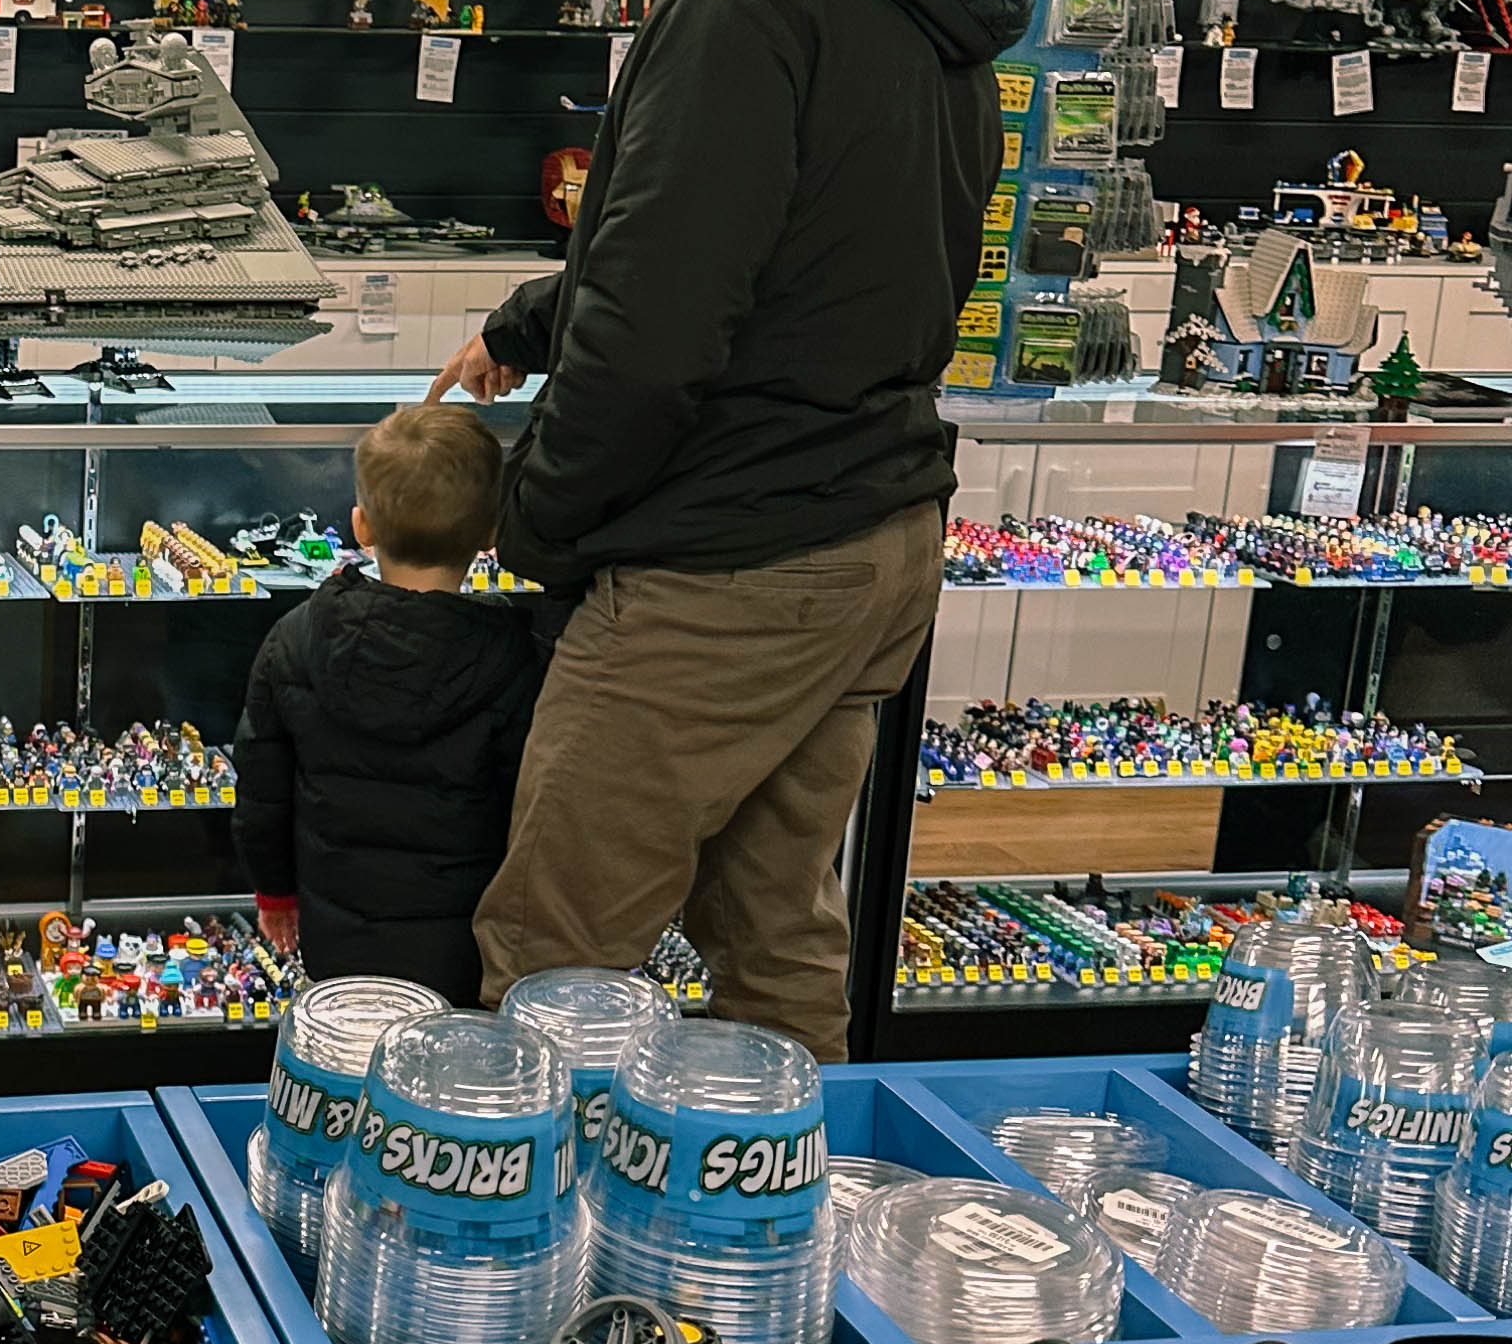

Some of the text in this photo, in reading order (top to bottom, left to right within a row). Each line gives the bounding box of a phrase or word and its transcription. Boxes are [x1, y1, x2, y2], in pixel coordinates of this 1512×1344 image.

[326, 1100, 355, 1138] &
[362, 1111, 385, 1149] &
[381, 1125, 531, 1197] BRICKS
